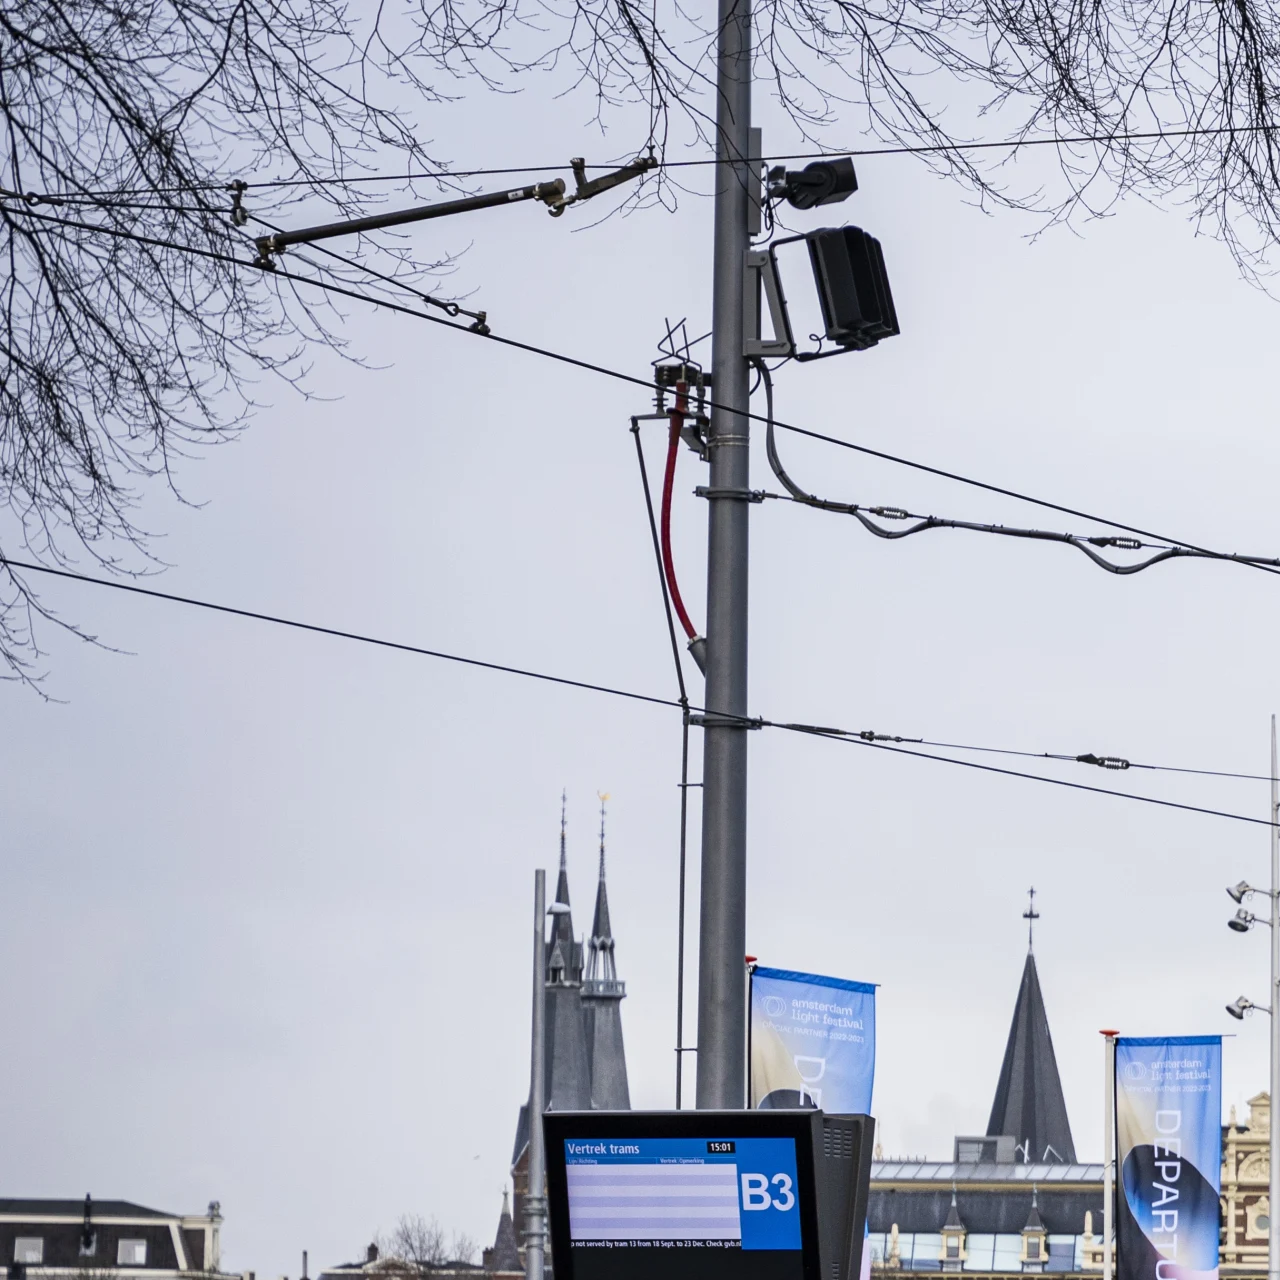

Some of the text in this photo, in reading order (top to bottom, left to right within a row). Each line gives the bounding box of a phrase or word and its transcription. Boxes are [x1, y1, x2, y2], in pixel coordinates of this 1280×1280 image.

[792, 999, 853, 1016] amsterdam
[792, 1009, 864, 1030] light festival
[793, 1026, 865, 1043] PARTNER 2022-2023
[1175, 1069, 1211, 1080] festival
[568, 1143, 640, 1155] Vertrek trams
[710, 1143, 731, 1151] 15:01
[741, 1173, 795, 1211] B3
[605, 1240, 613, 1248] by
[660, 1240, 675, 1248] Sept.
[724, 1240, 741, 1248] gvb.nl
